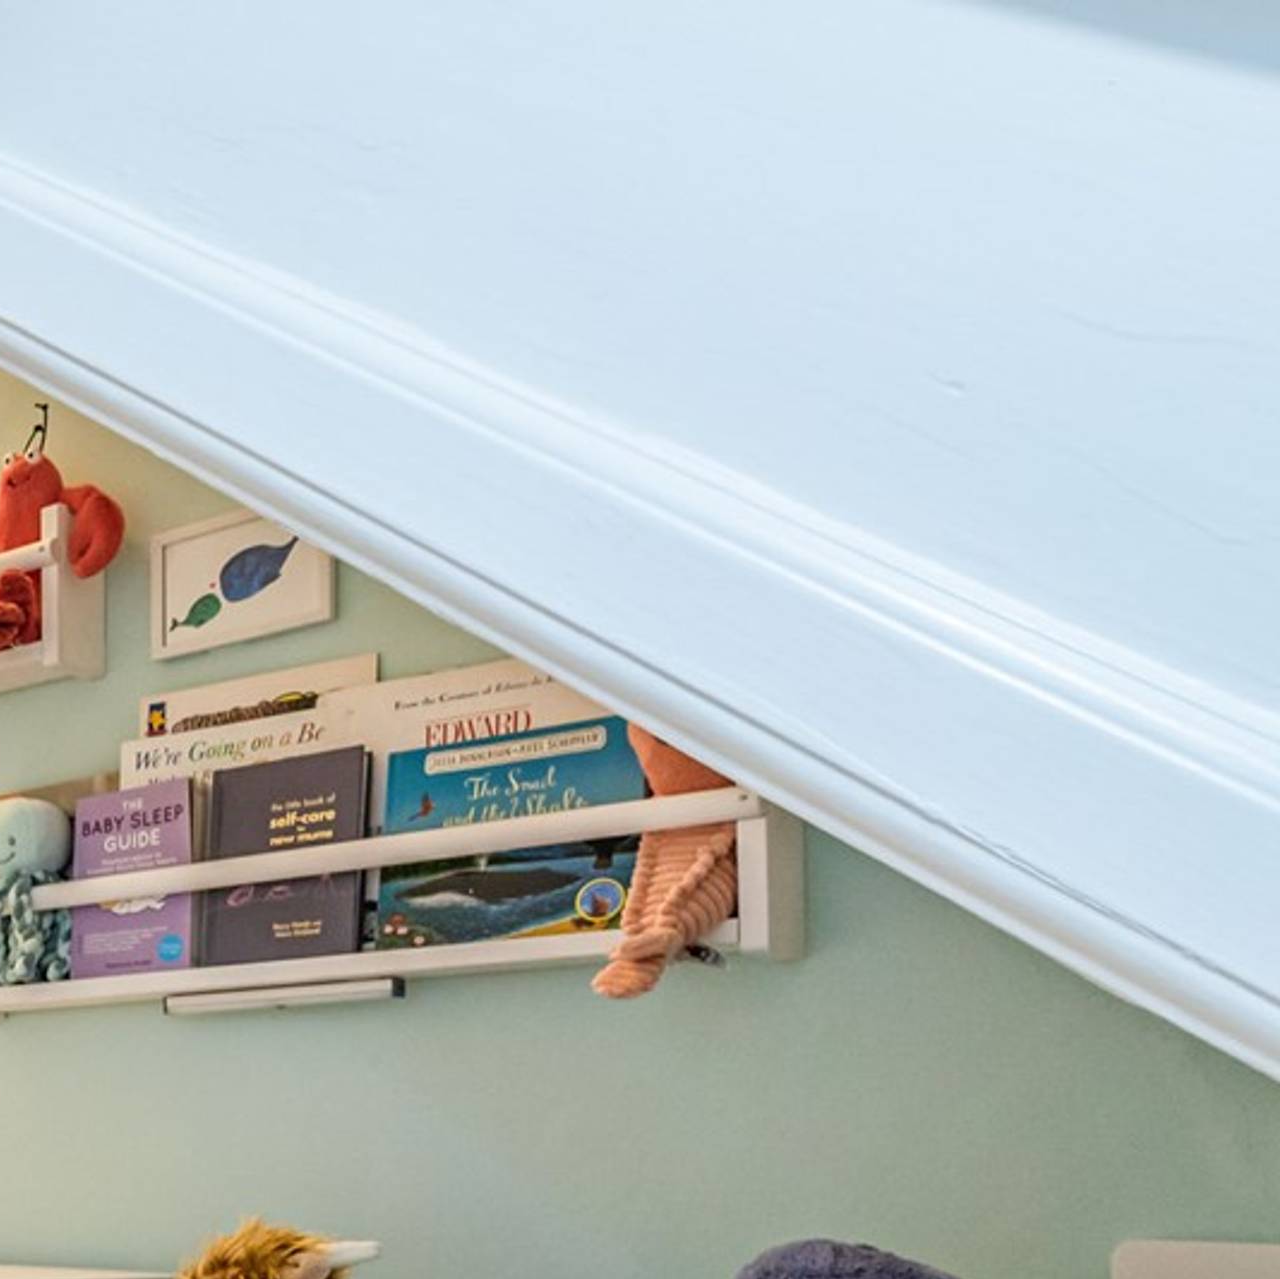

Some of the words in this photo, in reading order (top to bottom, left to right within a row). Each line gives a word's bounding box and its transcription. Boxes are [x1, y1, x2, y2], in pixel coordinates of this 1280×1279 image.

[424, 709, 532, 748] EDWARD
[134, 747, 182, 771] We're
[187, 738, 247, 763] Going
[251, 734, 274, 752] on
[279, 731, 292, 747] a
[463, 772, 498, 800] The
[504, 765, 557, 797] Snail
[81, 815, 125, 838] BABY
[130, 803, 184, 829] SLEEP
[122, 798, 143, 811] THE
[269, 809, 336, 830] self-care
[103, 828, 161, 853] GUIDE
